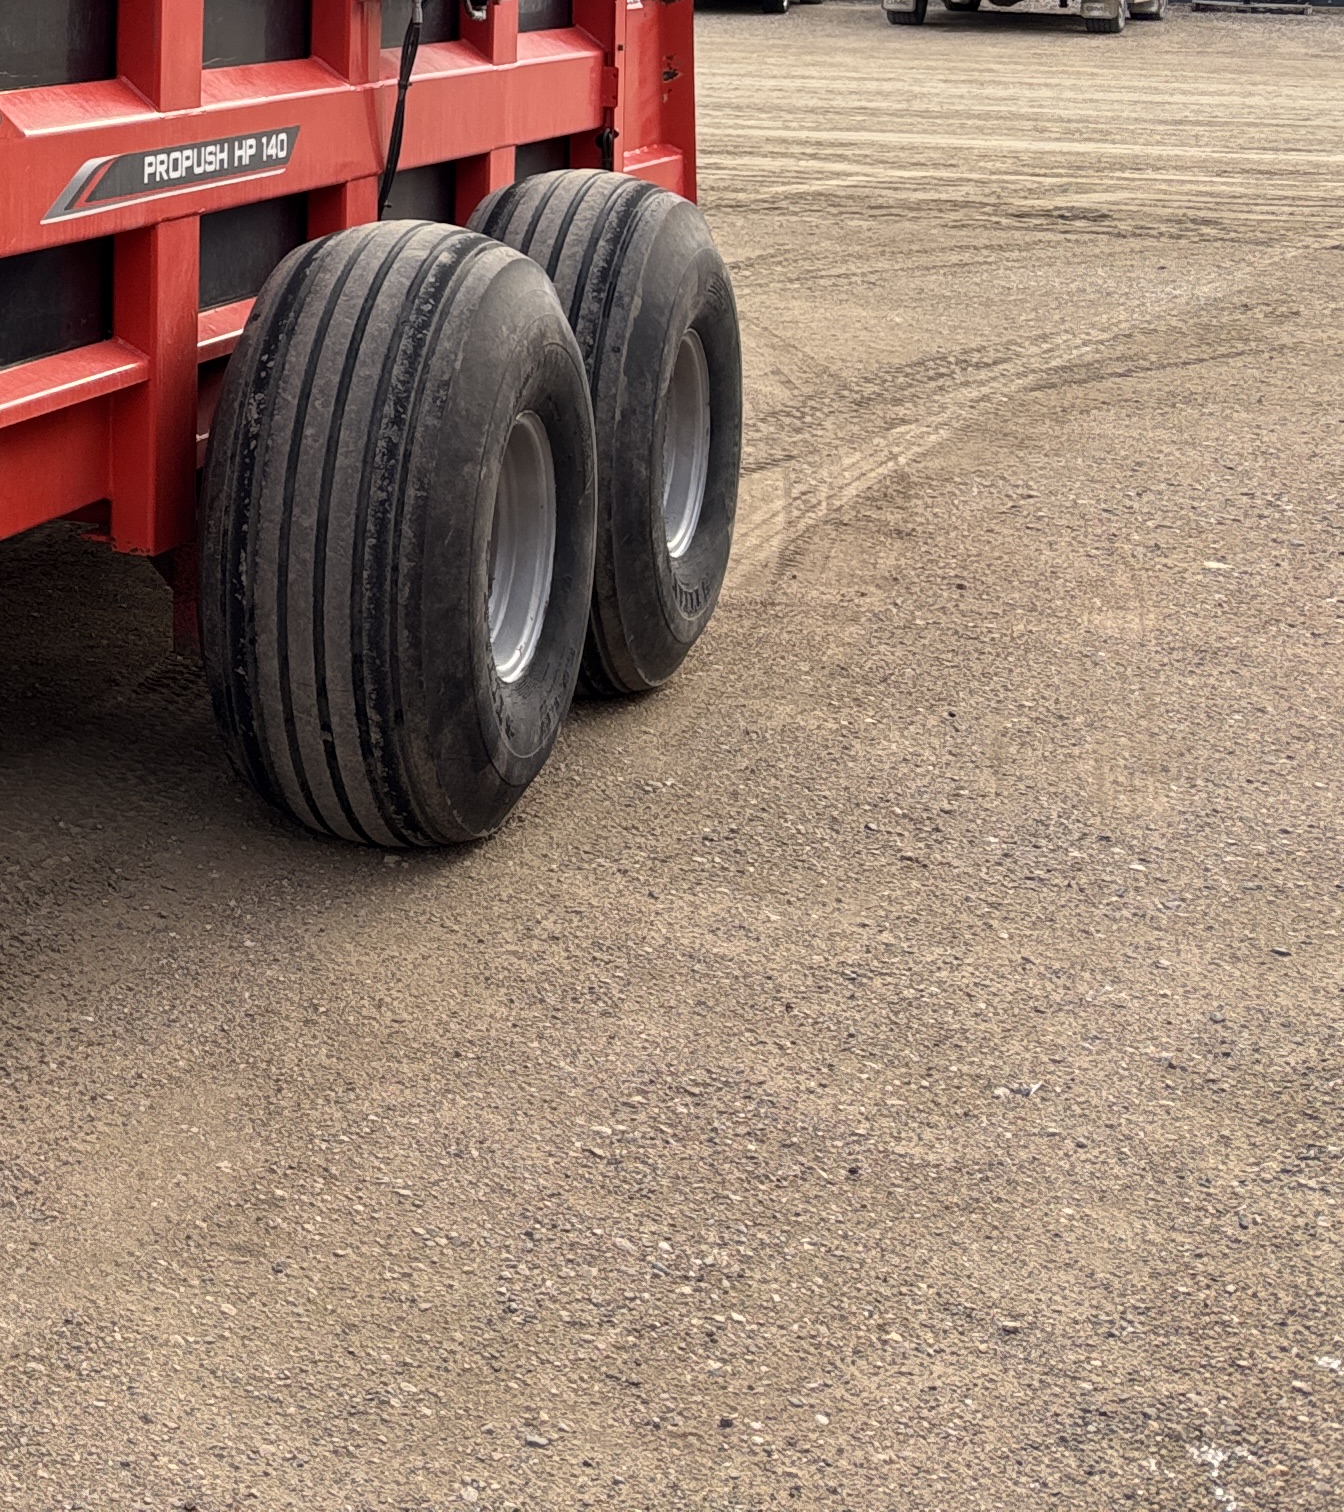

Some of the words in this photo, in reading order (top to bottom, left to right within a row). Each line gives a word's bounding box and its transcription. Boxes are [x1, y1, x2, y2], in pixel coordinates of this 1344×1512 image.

[144, 143, 229, 184] PROPUSH
[234, 138, 257, 167] HP
[262, 132, 288, 162] 140
